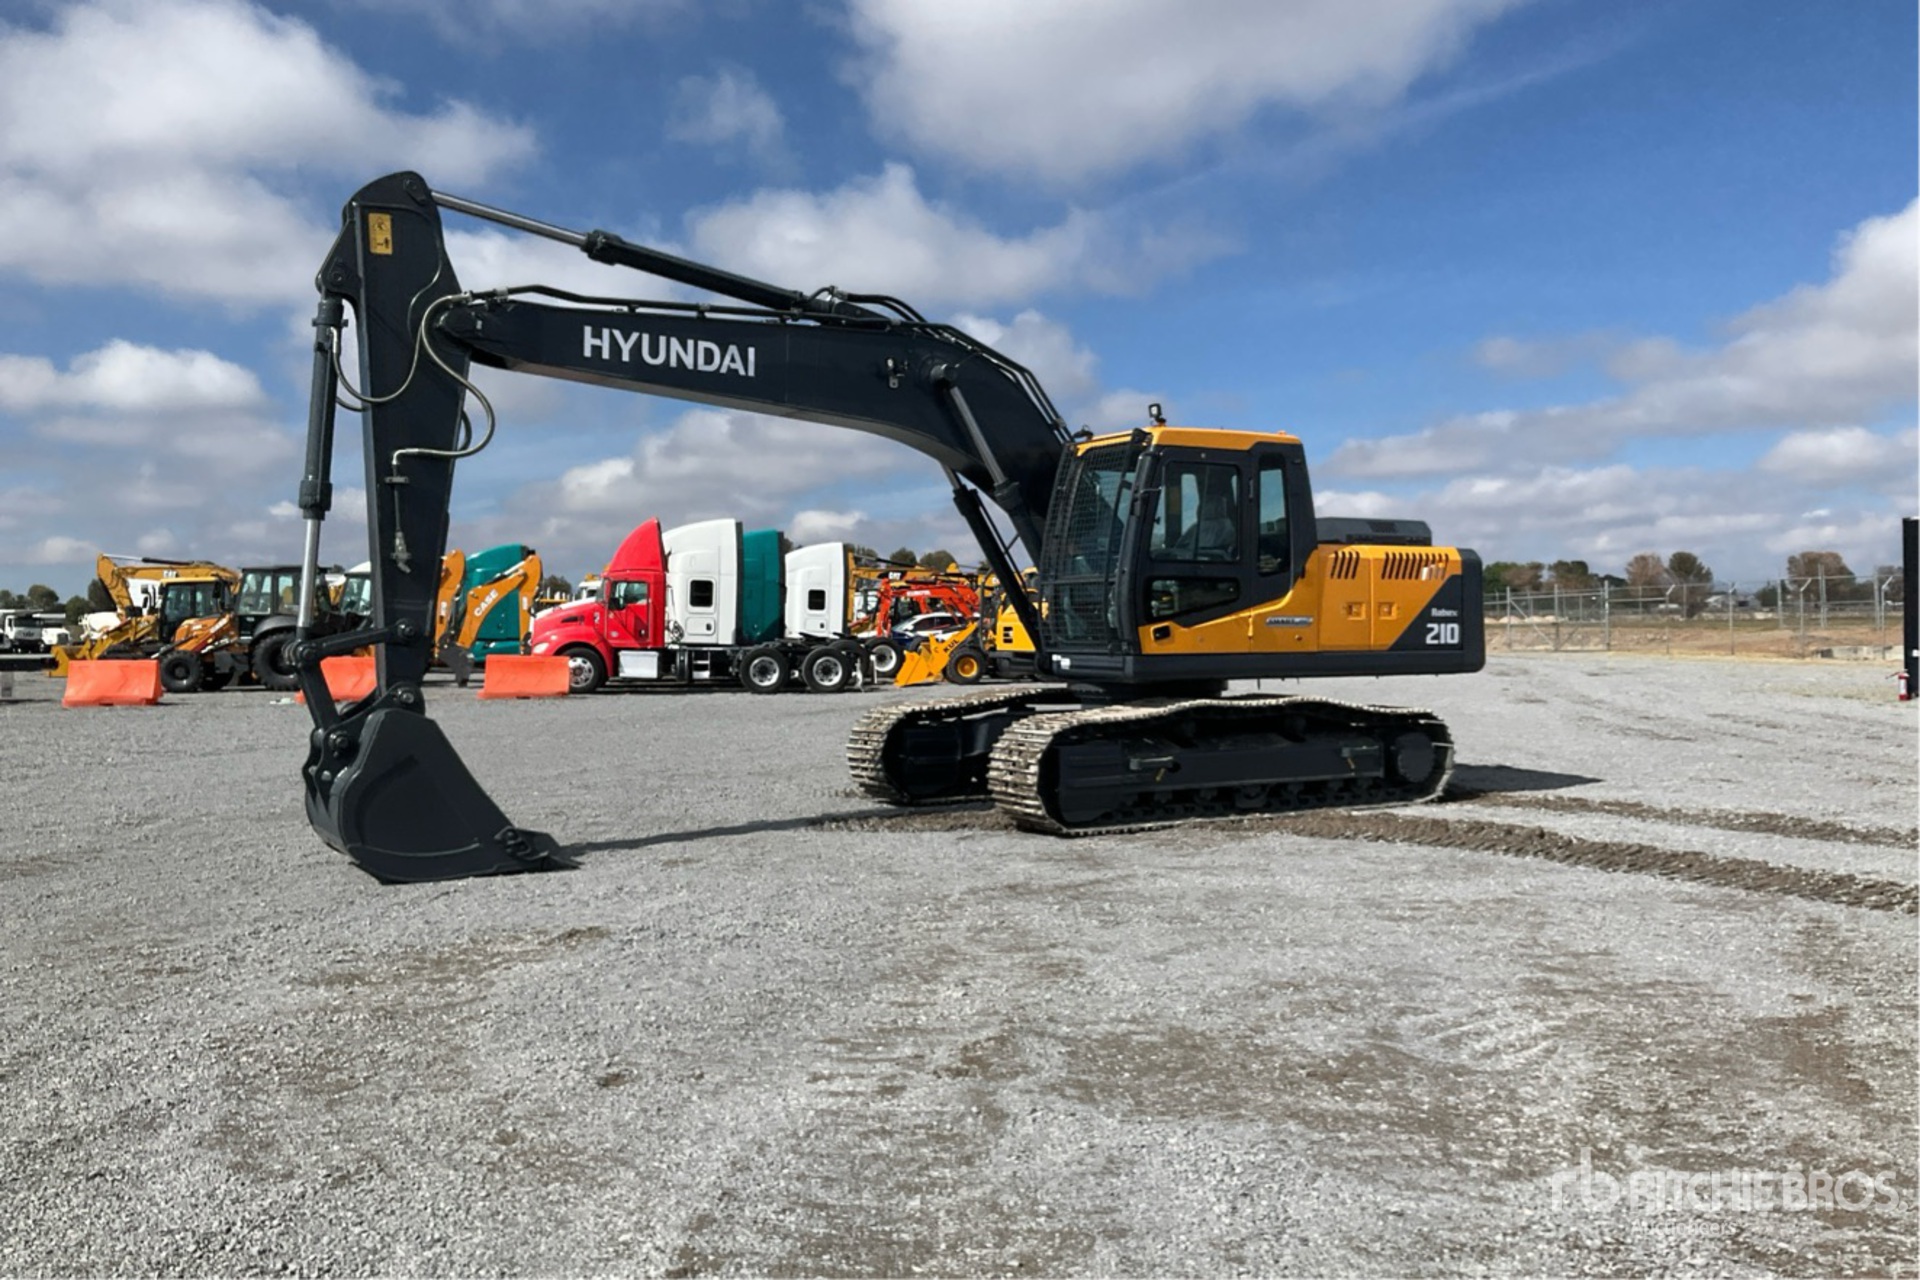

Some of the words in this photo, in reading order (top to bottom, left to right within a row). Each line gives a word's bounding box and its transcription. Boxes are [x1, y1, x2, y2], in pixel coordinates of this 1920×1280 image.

[583, 325, 755, 377] HYUNDAI
[474, 589, 499, 617] CASE
[1426, 623, 1459, 644] 210
